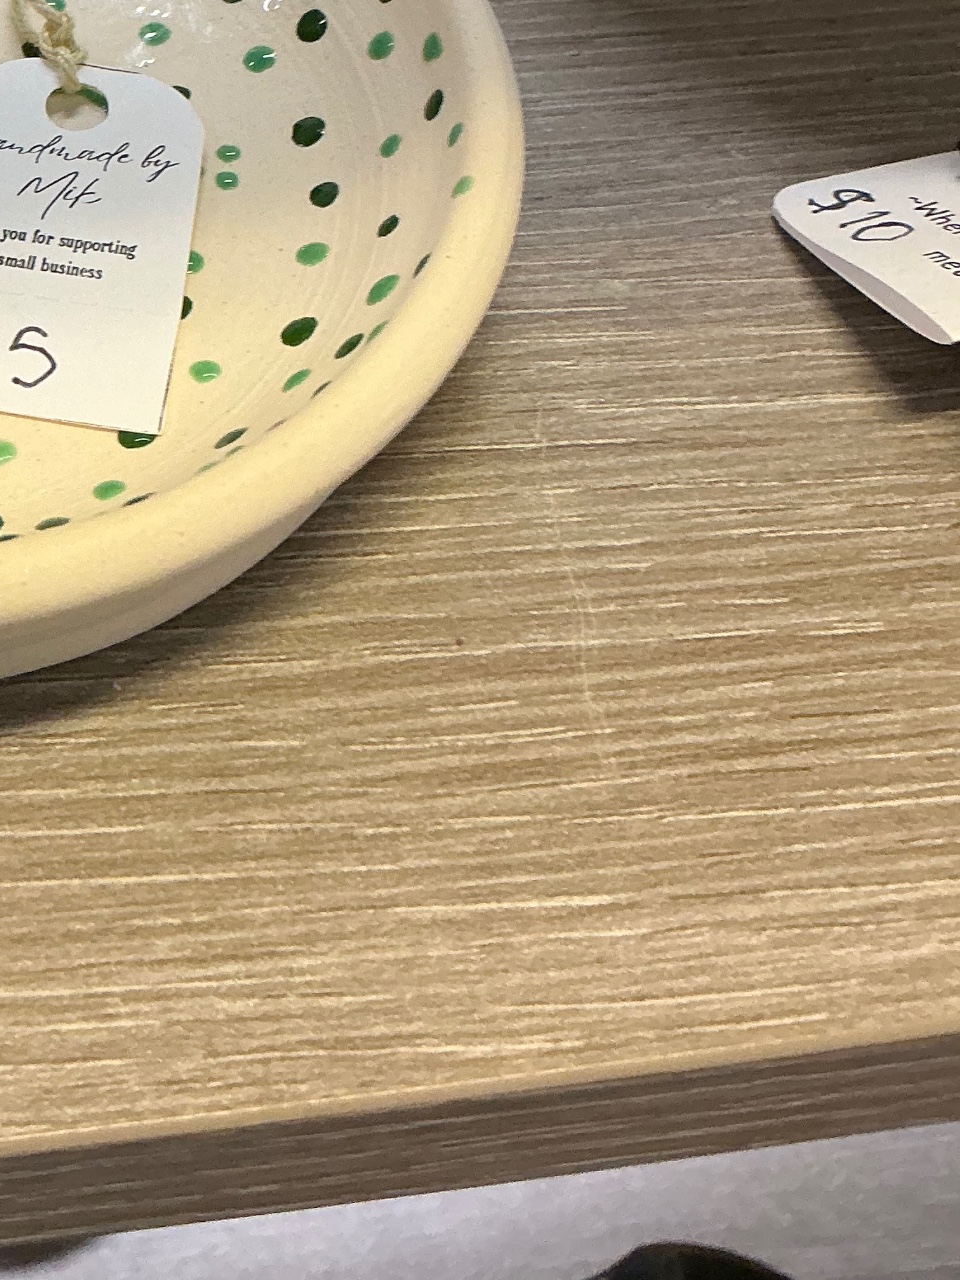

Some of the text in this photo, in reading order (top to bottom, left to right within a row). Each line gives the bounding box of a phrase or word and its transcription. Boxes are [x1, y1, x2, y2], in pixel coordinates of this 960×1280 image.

[140, 145, 180, 183] by
[0, 227, 27, 243] you
[31, 229, 54, 246] for
[58, 235, 138, 260] supporting
[40, 258, 103, 280] business
